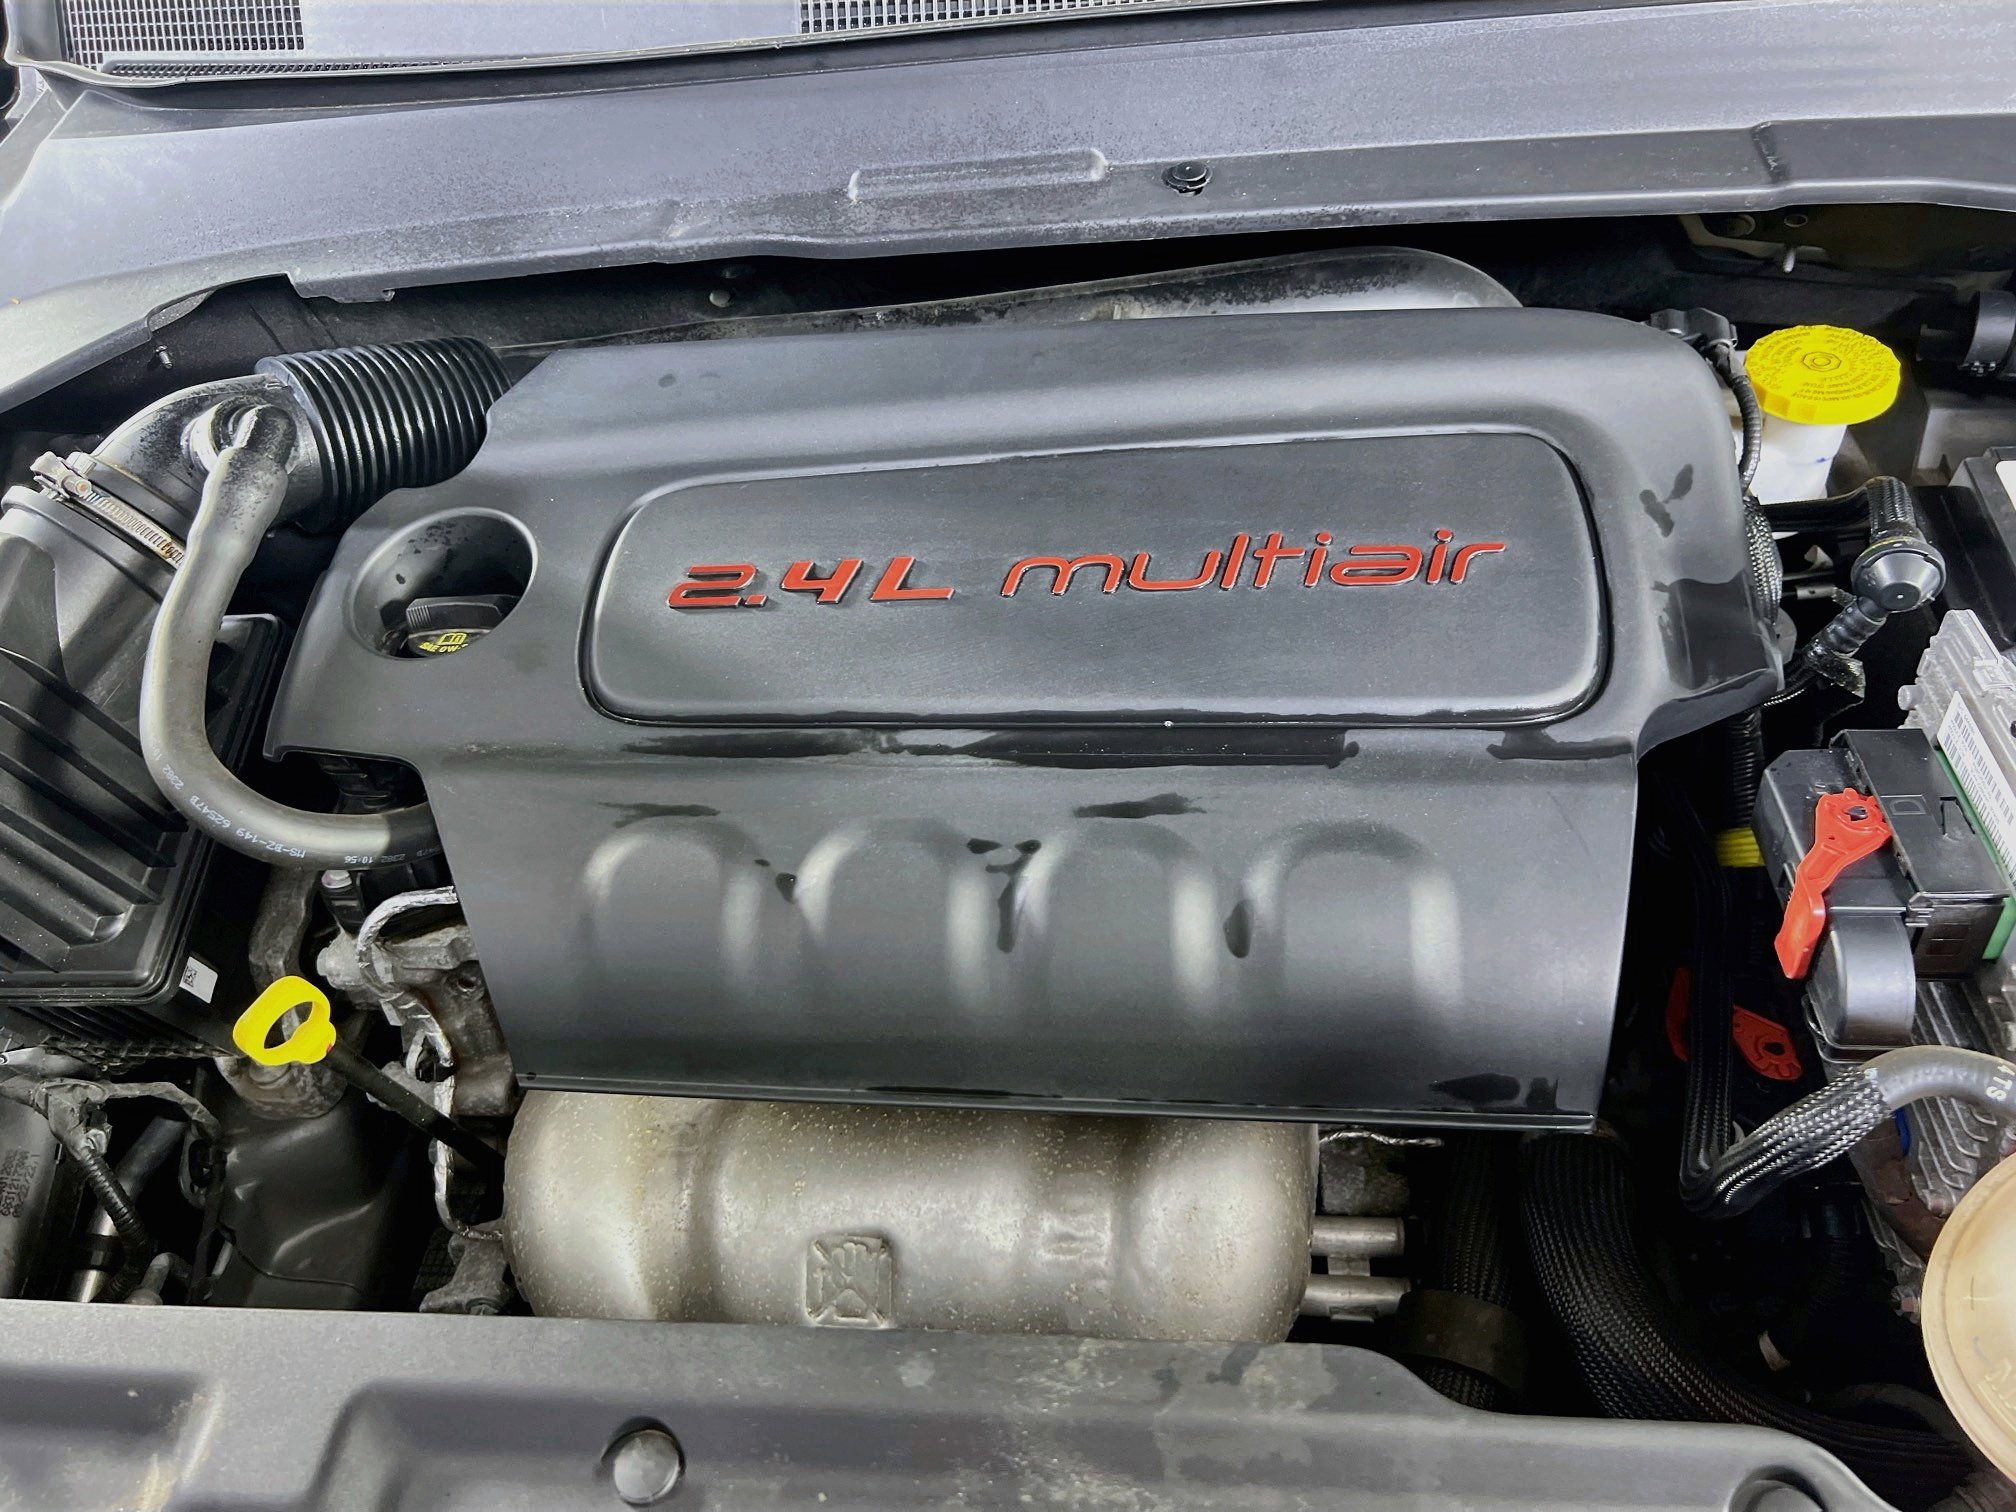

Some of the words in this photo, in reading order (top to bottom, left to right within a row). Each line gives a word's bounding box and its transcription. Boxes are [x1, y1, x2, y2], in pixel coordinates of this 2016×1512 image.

[667, 556, 955, 610] 2.4L
[1001, 527, 1507, 597] multiair
[420, 642, 440, 652] SAE
[440, 644, 468, 652] 0W-
[189, 794, 232, 828] 62547B
[235, 826, 307, 859] MS-BZ-149
[343, 854, 374, 864] 10:56
